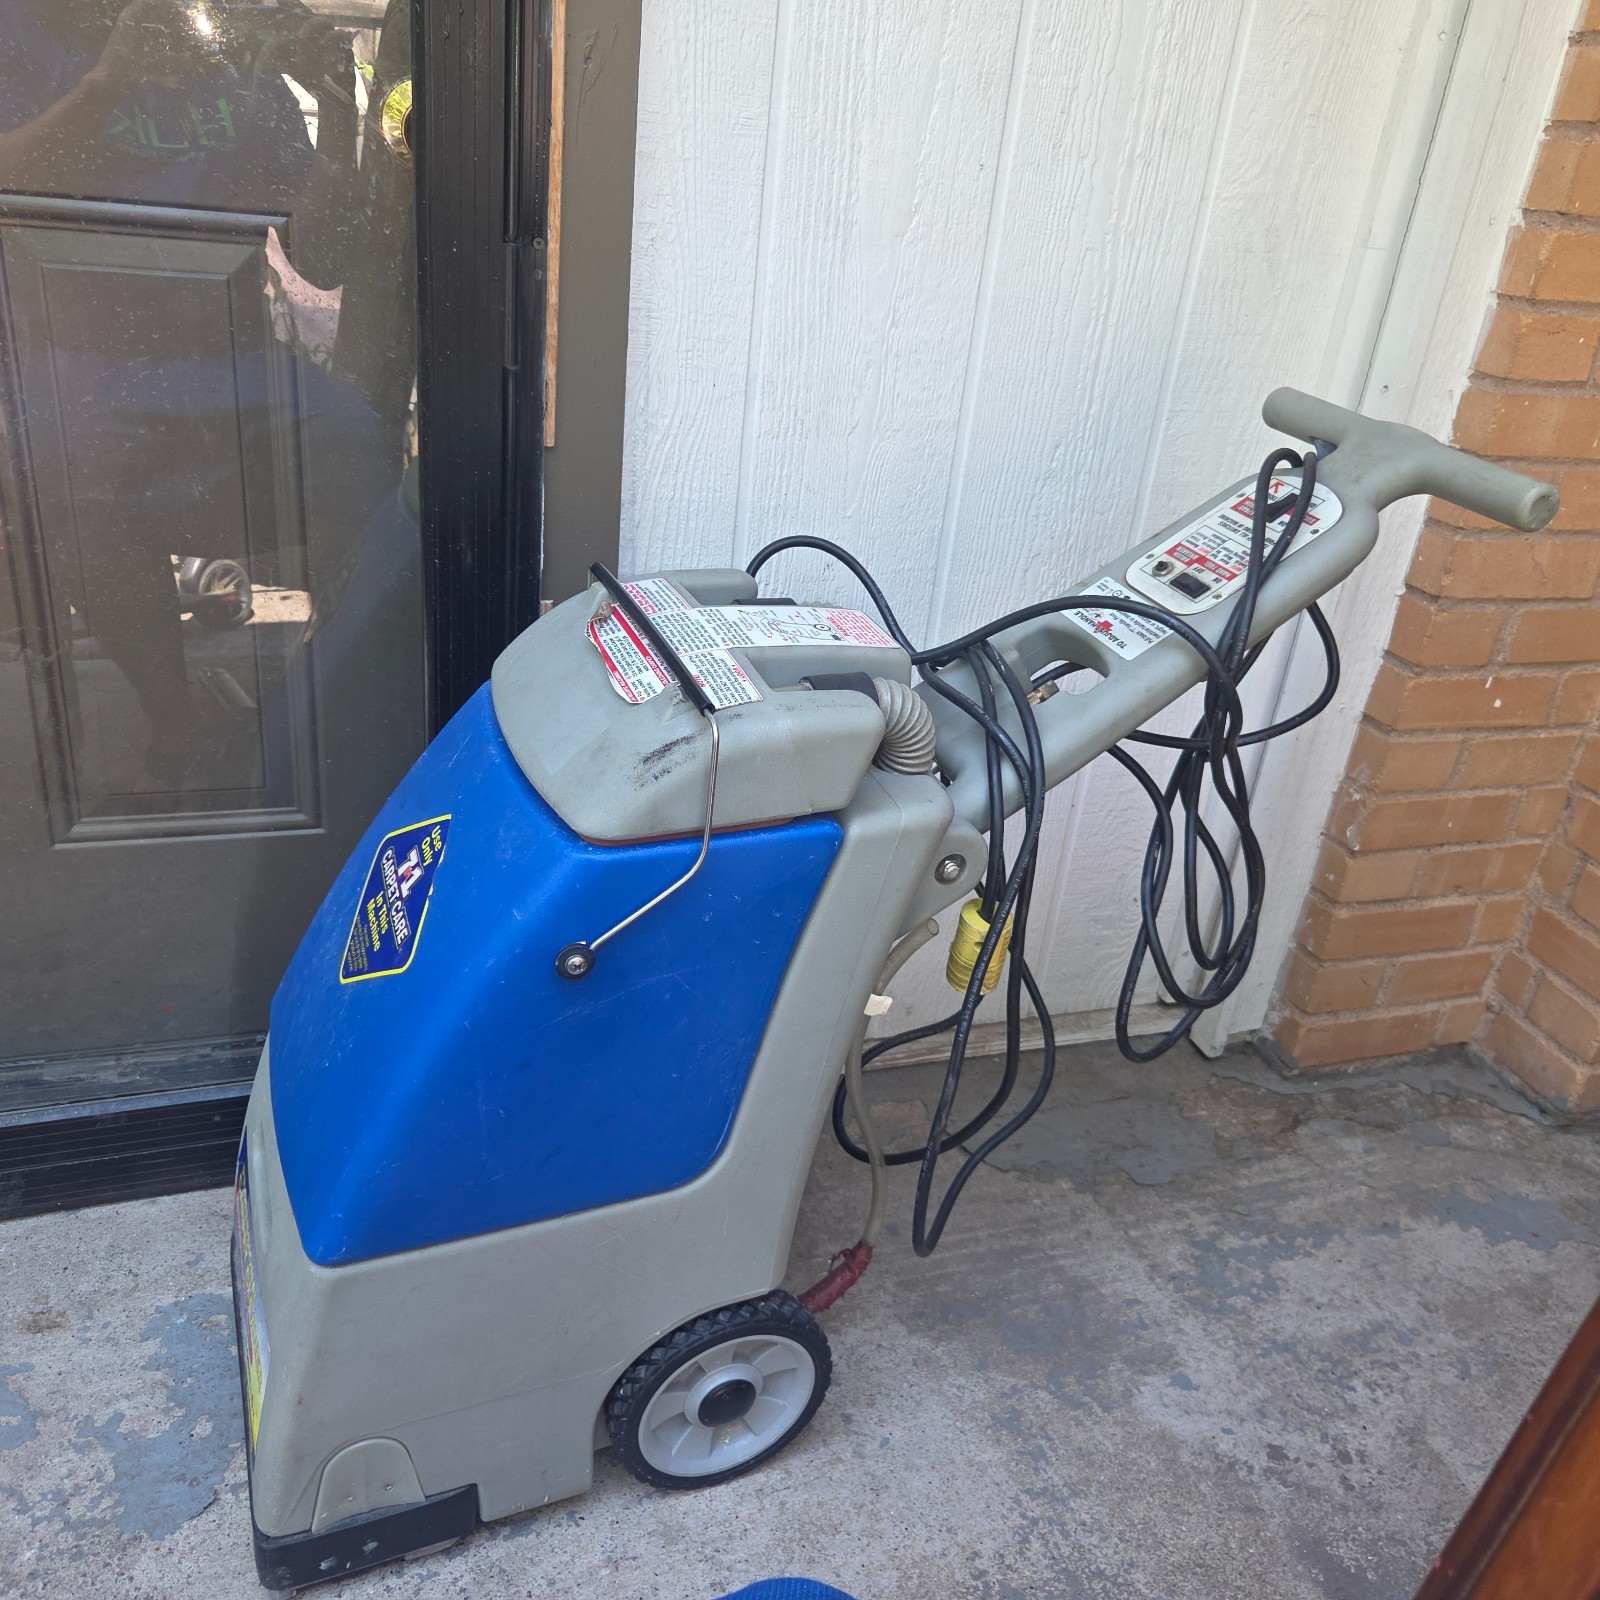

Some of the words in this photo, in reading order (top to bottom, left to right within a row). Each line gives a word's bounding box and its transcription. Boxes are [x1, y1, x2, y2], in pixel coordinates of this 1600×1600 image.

[1216, 520, 1242, 534] SWITCHES
[1191, 565, 1205, 574] OFF
[1213, 567, 1232, 577] HAND
[1073, 609, 1098, 628] HANDLE
[1093, 624, 1120, 643] ADJUST
[1134, 630, 1146, 639] back
[1142, 636, 1154, 644] Pull
[1115, 640, 1128, 648] TO
[431, 825, 442, 852] Use
[421, 836, 433, 867] Only
[375, 890, 385, 903] In
[382, 849, 400, 902] CARPET
[391, 900, 408, 945] CARE
[366, 898, 381, 952] Machine
[378, 902, 389, 935] This
